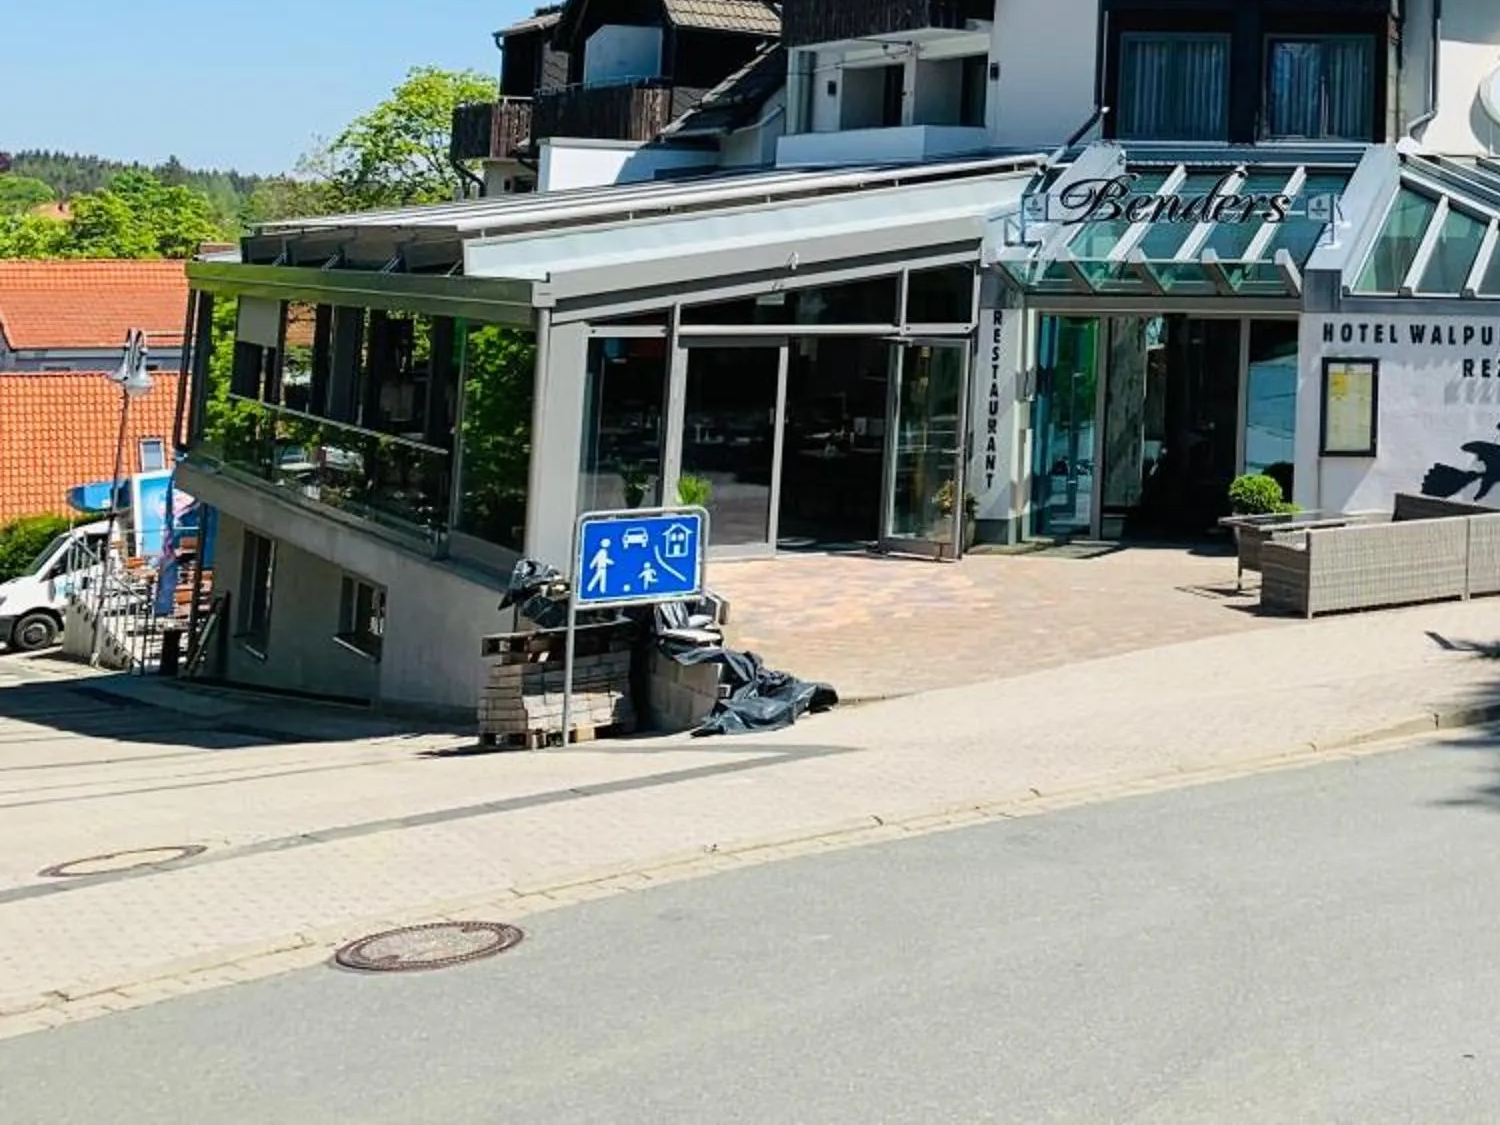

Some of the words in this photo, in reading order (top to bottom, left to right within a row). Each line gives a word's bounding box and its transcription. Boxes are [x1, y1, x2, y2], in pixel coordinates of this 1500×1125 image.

[1059, 171, 1294, 225] Benders
[1322, 323, 1398, 344] HOTEL
[985, 310, 1003, 490] RESTAURANT
